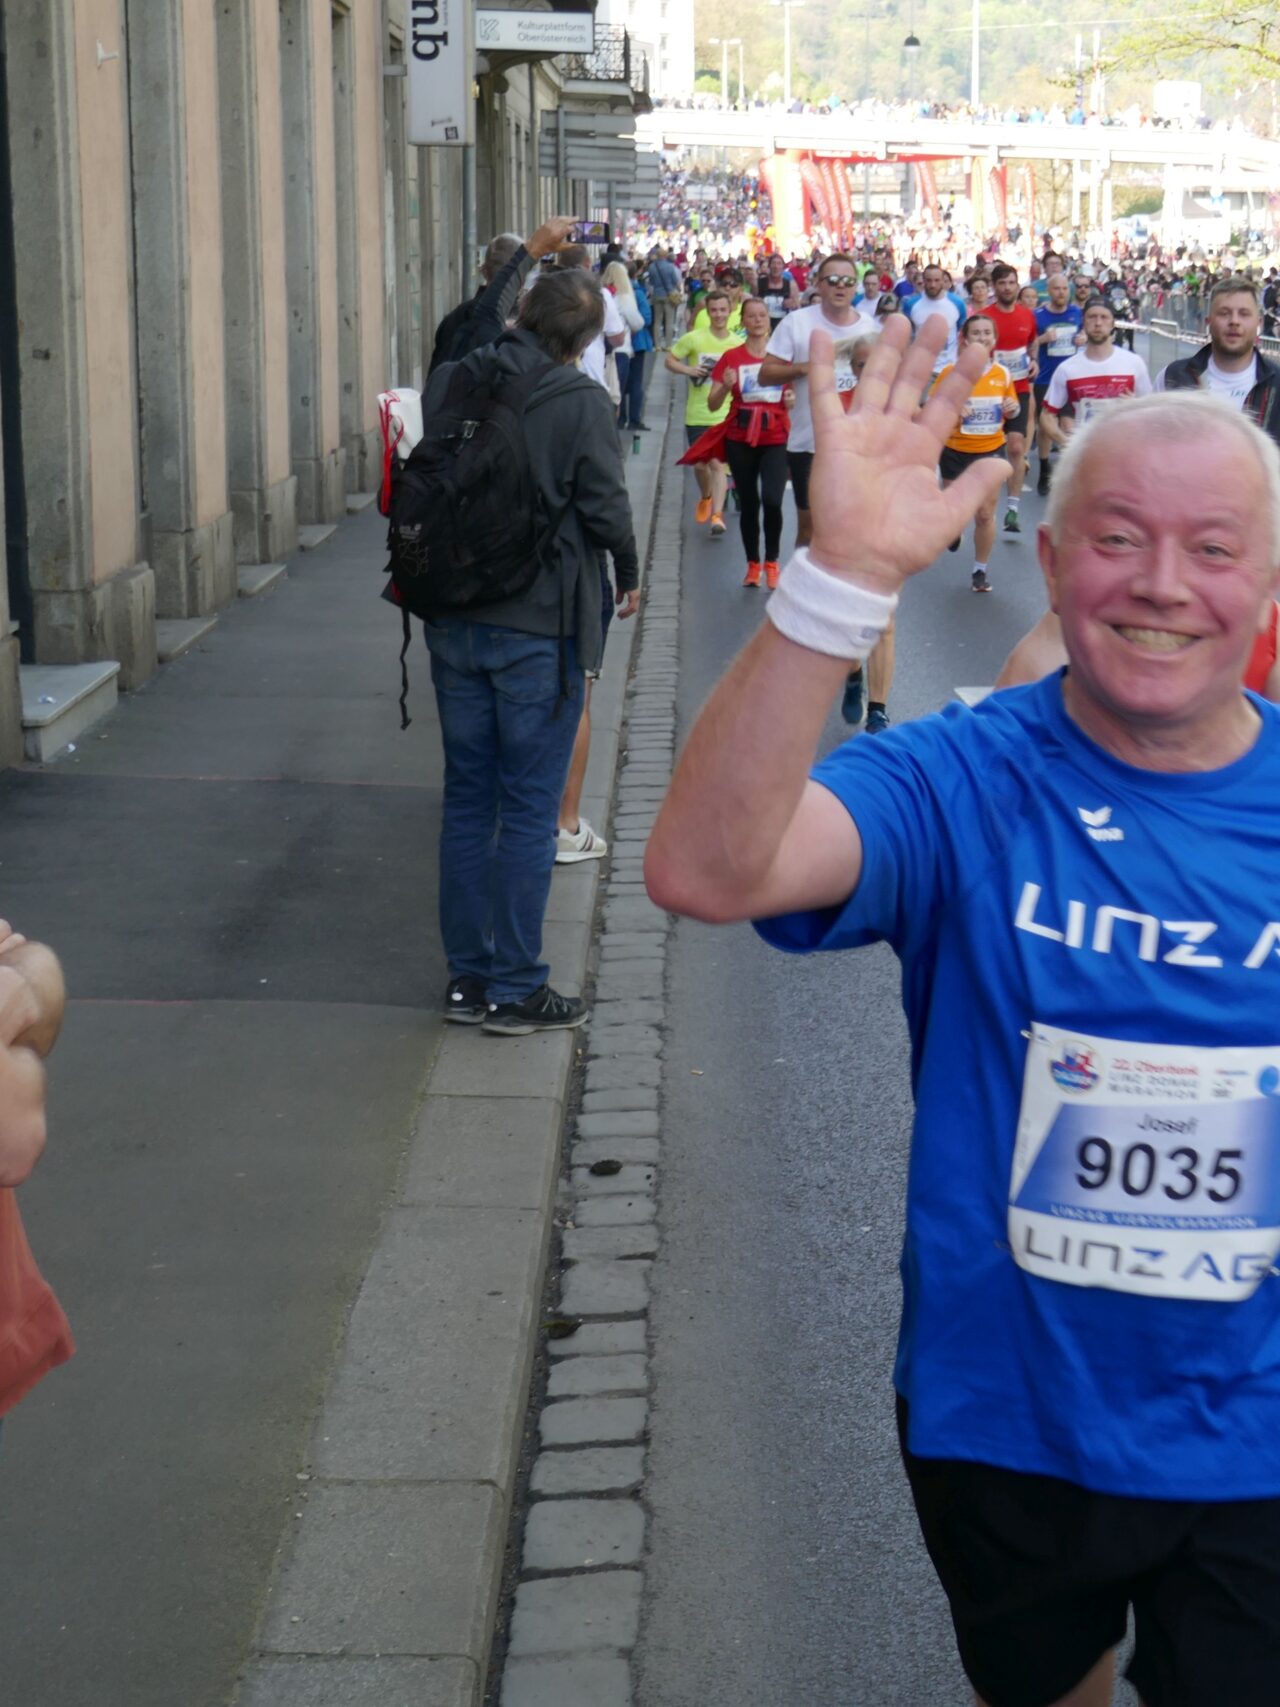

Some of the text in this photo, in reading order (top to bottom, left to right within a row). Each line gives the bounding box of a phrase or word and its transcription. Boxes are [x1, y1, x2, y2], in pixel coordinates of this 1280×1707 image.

[517, 20, 586, 32] Kulturplattform
[517, 31, 587, 43] Oberösterreich
[1014, 881, 1224, 969] LINZ
[1137, 1113, 1199, 1136] Josef
[1075, 1136, 1244, 1203] 9035
[1025, 1225, 1277, 1284] LINZ AG
